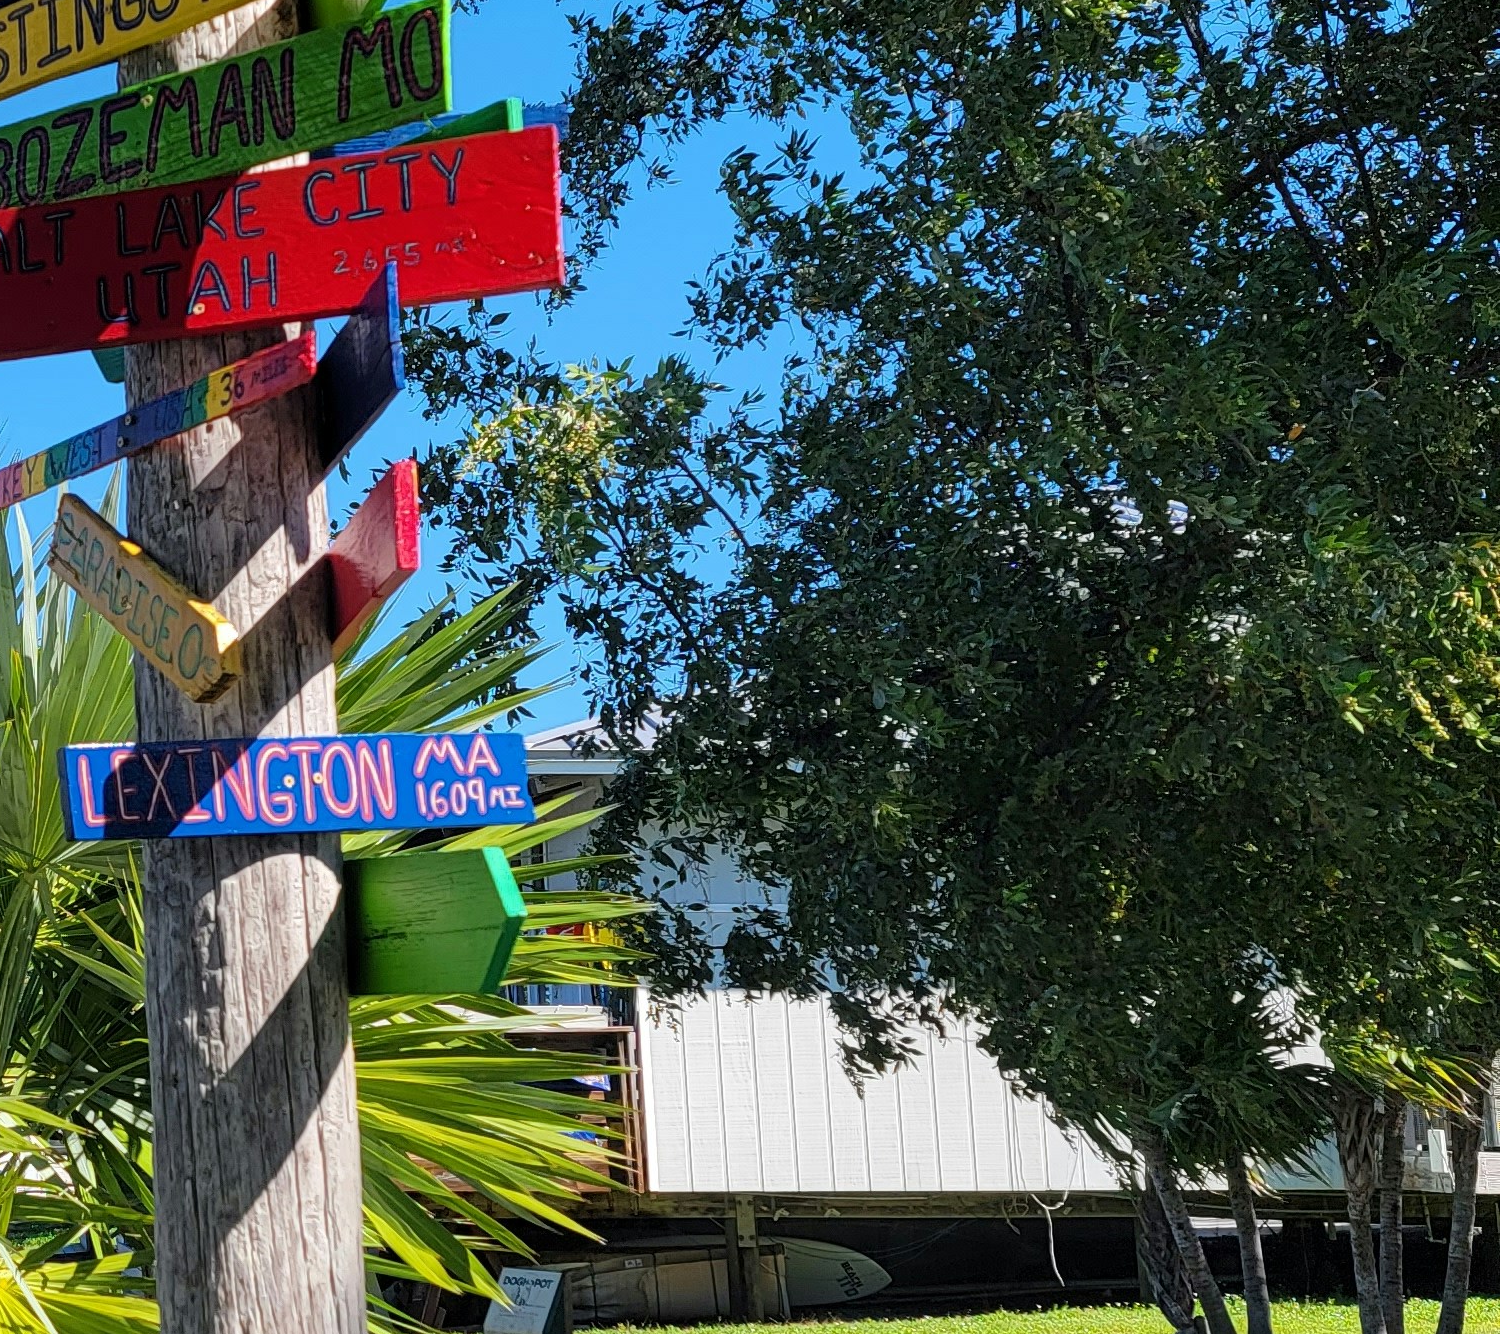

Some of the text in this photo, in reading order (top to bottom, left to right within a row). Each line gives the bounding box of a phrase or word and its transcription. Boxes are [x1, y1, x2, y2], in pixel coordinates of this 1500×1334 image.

[337, 7, 444, 123] MO
[115, 179, 267, 257] LAKE
[301, 148, 466, 227] CITY
[98, 249, 280, 325] UTAH
[1, 455, 41, 503] KEY
[46, 426, 109, 480] WEST
[220, 369, 245, 406] 36
[76, 733, 501, 825] LEXINGTON MA
[489, 785, 527, 809] MI
